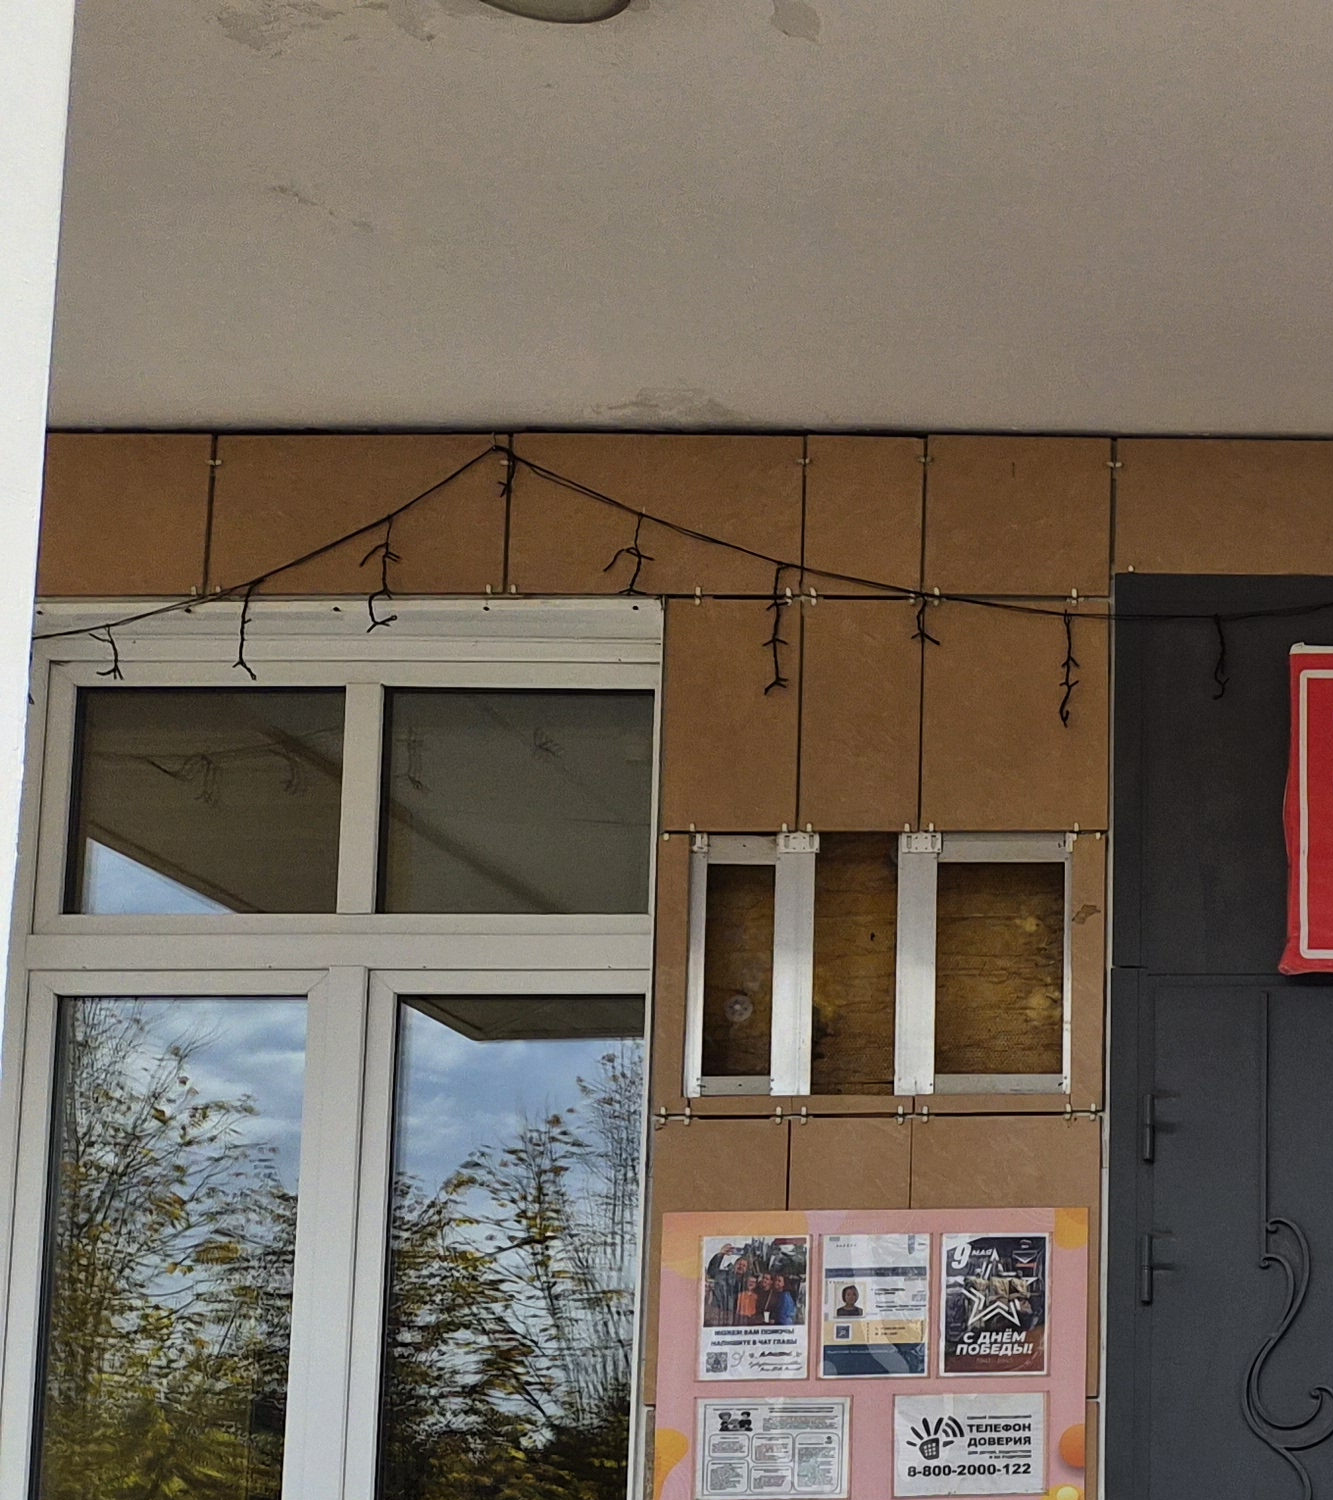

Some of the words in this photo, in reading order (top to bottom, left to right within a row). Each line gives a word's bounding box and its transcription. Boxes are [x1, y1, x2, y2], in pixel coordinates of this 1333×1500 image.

[951, 1243, 971, 1269] 9
[963, 1332, 974, 1343] С
[977, 1328, 1026, 1345] ДНЁМ
[956, 1343, 1034, 1356] ПОБЕДЫ!
[967, 1423, 1031, 1433] ТЕЛЕФОН
[967, 1436, 1031, 1448] ДОВЕРИЯ
[907, 1463, 1032, 1477] 8-800-2000-122
